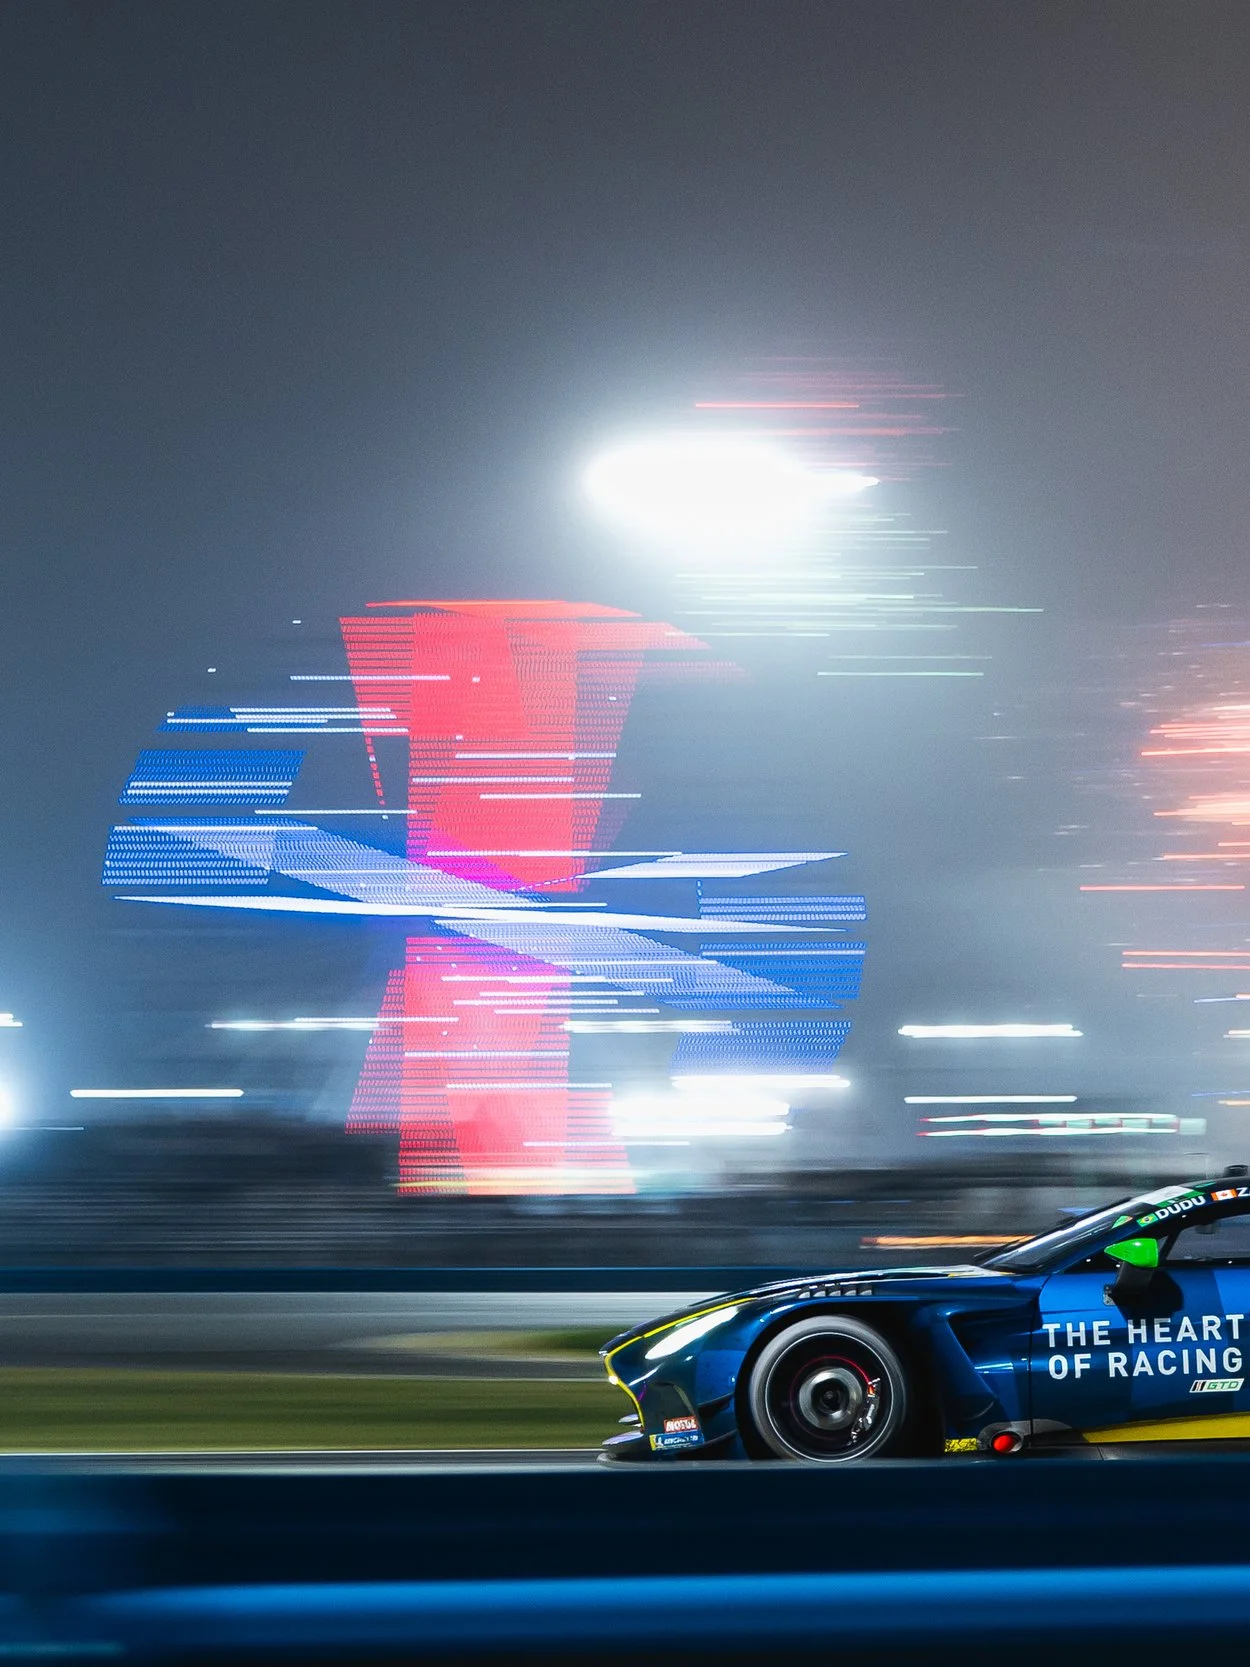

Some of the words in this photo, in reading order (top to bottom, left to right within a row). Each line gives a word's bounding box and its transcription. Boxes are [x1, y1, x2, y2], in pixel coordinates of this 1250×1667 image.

[1155, 1195, 1206, 1220] DUDU
[1042, 1320, 1111, 1348] THE
[1127, 1313, 1244, 1344] HEART
[1048, 1353, 1092, 1380] OF
[1108, 1347, 1243, 1378] RACING
[665, 1419, 697, 1431] MOTUL
